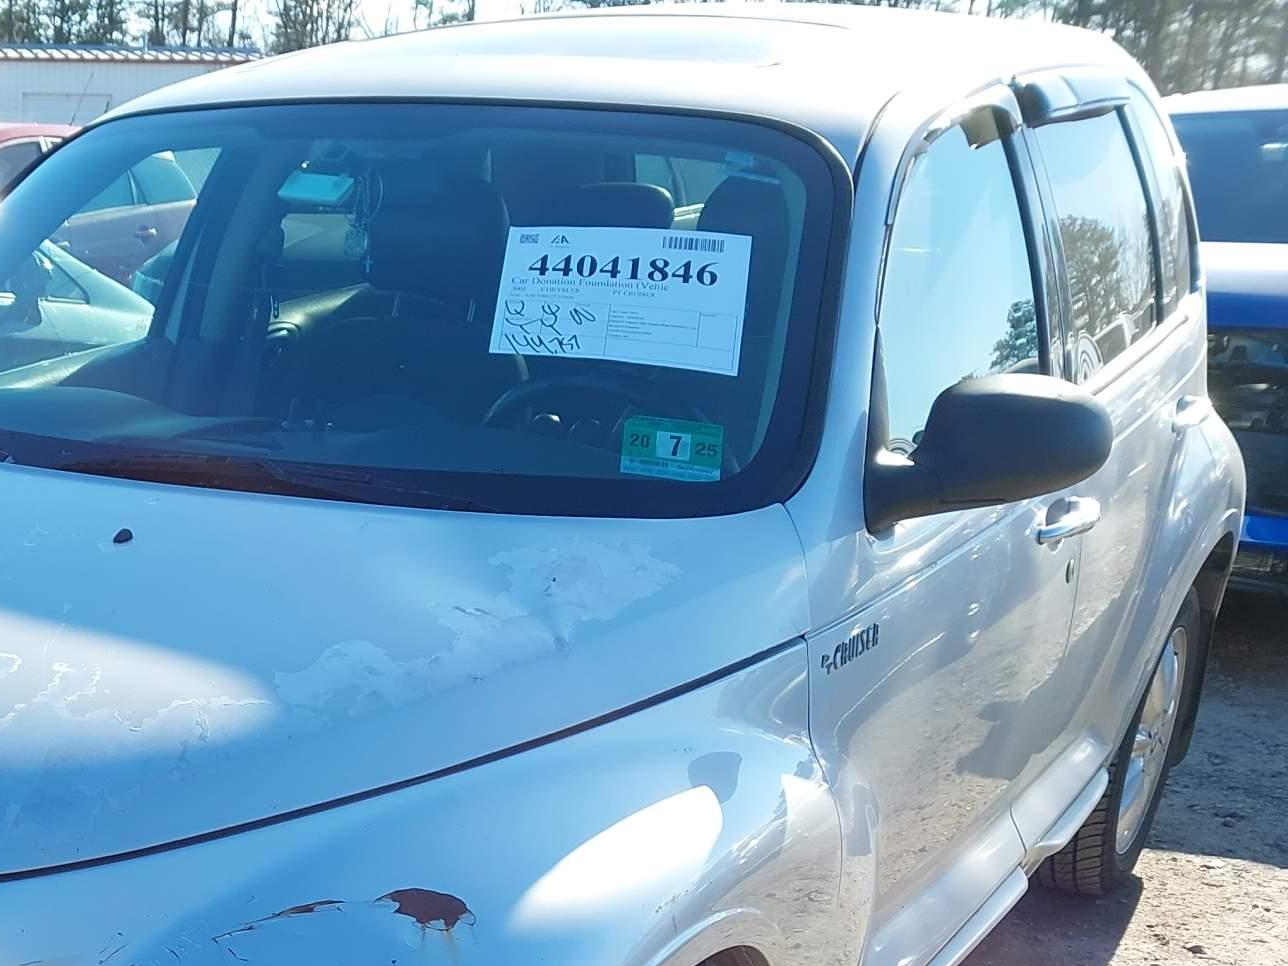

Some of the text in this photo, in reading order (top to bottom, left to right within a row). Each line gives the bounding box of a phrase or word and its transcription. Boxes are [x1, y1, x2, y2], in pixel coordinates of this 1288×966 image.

[511, 277, 528, 285] Car
[532, 277, 573, 286] Donation
[579, 278, 633, 289] Foundation
[528, 254, 718, 286] 44041846
[629, 433, 718, 457] 20 7 25
[821, 623, 880, 675] PT CRUISER
